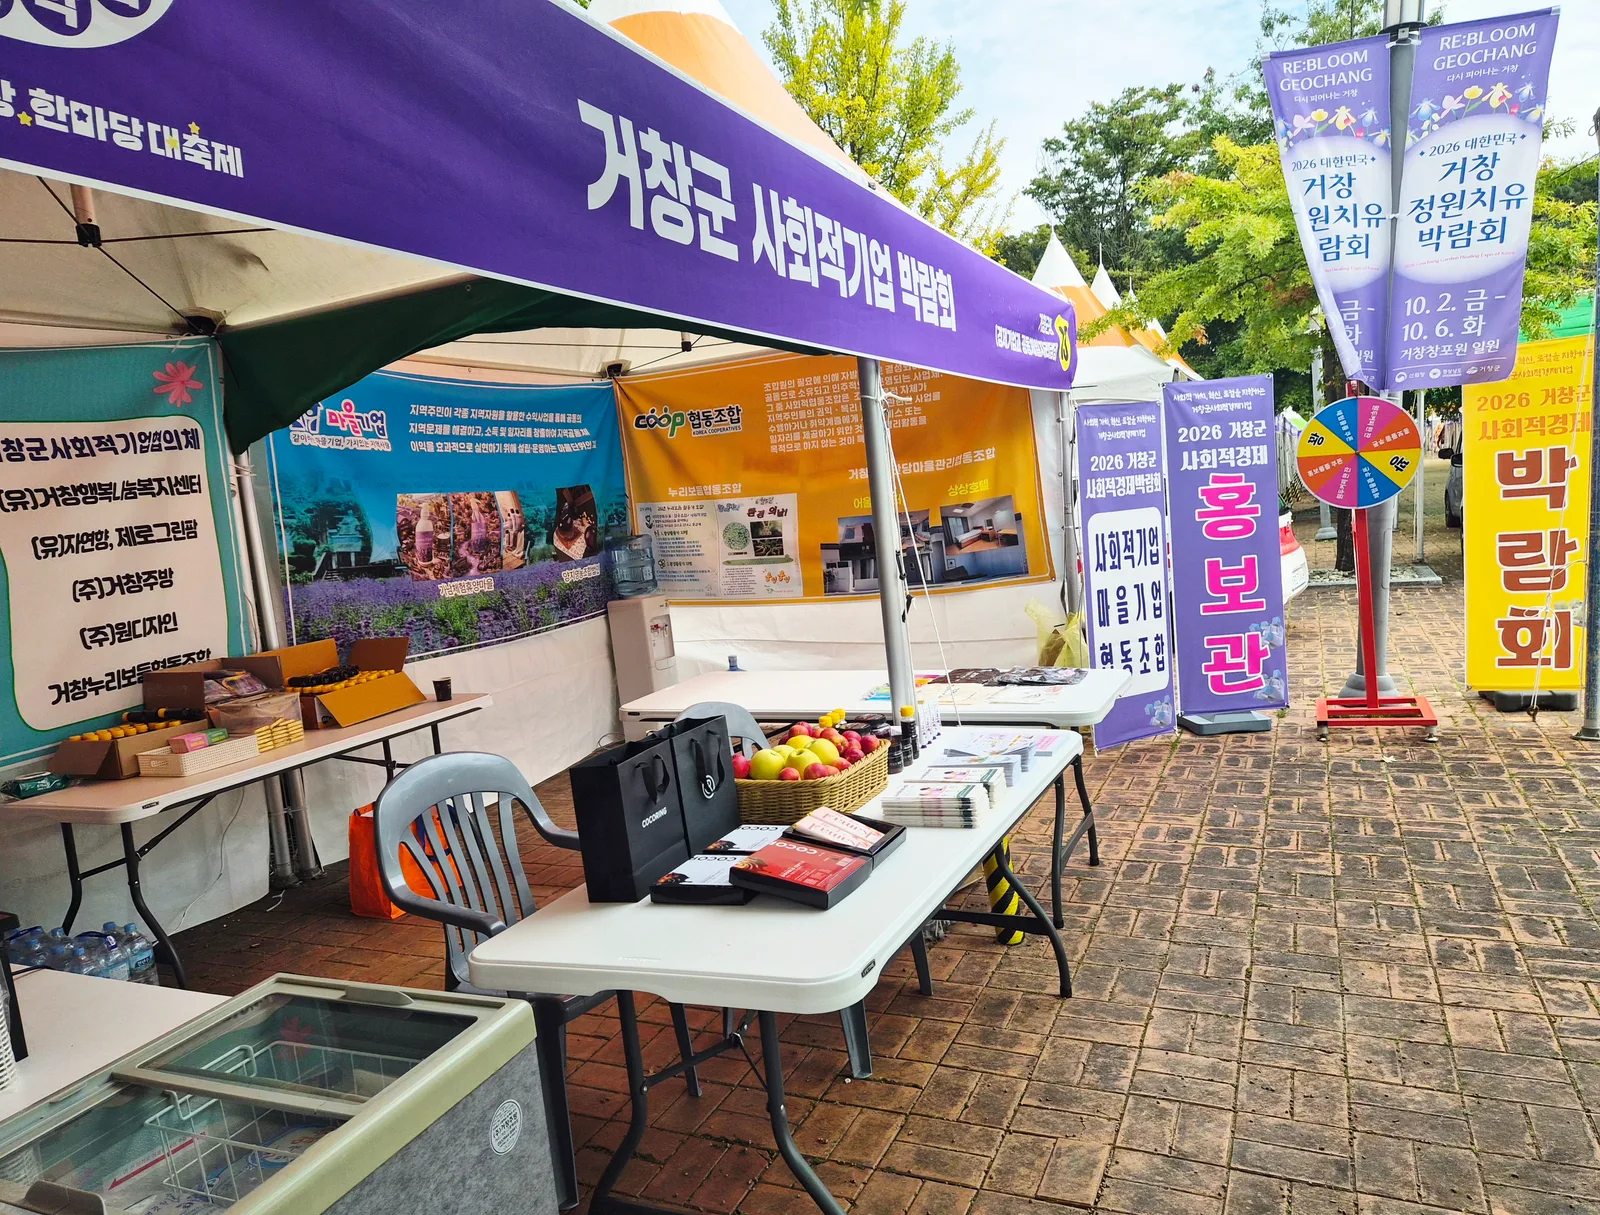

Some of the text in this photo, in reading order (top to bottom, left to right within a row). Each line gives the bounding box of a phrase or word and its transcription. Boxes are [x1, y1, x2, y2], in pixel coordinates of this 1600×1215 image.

[1439, 23, 1536, 51] RE:BLOOM
[1283, 49, 1368, 74] RE:BLOOM
[1433, 41, 1537, 71] GEOCHANG
[1279, 68, 1373, 92] GEOCHANG
[1447, 64, 1518, 83] 다시 피어나는 거창
[1294, 89, 1358, 103] 다시 피어나는 거창
[1430, 133, 1518, 157] 2026 대한민국
[1292, 154, 1368, 171] 2026 대한민국
[1438, 152, 1500, 184] 거창
[1303, 172, 1356, 199] 거창
[577, 99, 957, 332] 거창군 사회적기업 박람회
[1408, 183, 1528, 224] 정원치유
[1318, 233, 1370, 262] 람회
[1418, 217, 1508, 252] 박람회
[1340, 300, 1361, 321] 금
[1404, 289, 1488, 316] 10. 2. 금
[1402, 315, 1486, 342] 10. 6. 화
[1400, 339, 1500, 360] 거창창포원 일원
[1537, 352, 1559, 362] 로컬을
[1477, 384, 1591, 412] 2026 거창군
[327, 400, 387, 438] 마을기업
[410, 404, 452, 418] 지역주민이
[454, 407, 469, 419] 각종
[470, 408, 505, 420] 지역자원을
[687, 405, 741, 429] 협동조합
[1478, 411, 1591, 440] 사회적경제
[409, 423, 450, 436] 지역문제를
[485, 426, 498, 437] 소득
[708, 426, 741, 434] COOPERATIVES
[1178, 419, 1267, 443] 2026 거창군
[0, 428, 200, 462] 창군사회적기업협의체
[410, 441, 434, 453] 이익을
[436, 441, 473, 453] 효과적으로
[1180, 445, 1268, 472] 사회적경제
[1090, 450, 1157, 471] 2026 거창군
[948, 479, 990, 497] 상상호텔
[1086, 472, 1161, 499] 사회적경제박람회
[115, 519, 198, 547] 제로그린팜
[1095, 526, 1159, 573] 사회적기업
[1495, 446, 1579, 669] 박람회
[72, 567, 174, 602] (주)거창주방
[1195, 473, 1271, 696] 홍보관
[1097, 580, 1163, 628] 마을기업
[79, 611, 178, 650] (주)원디자인
[641, 806, 667, 828] COCORING
